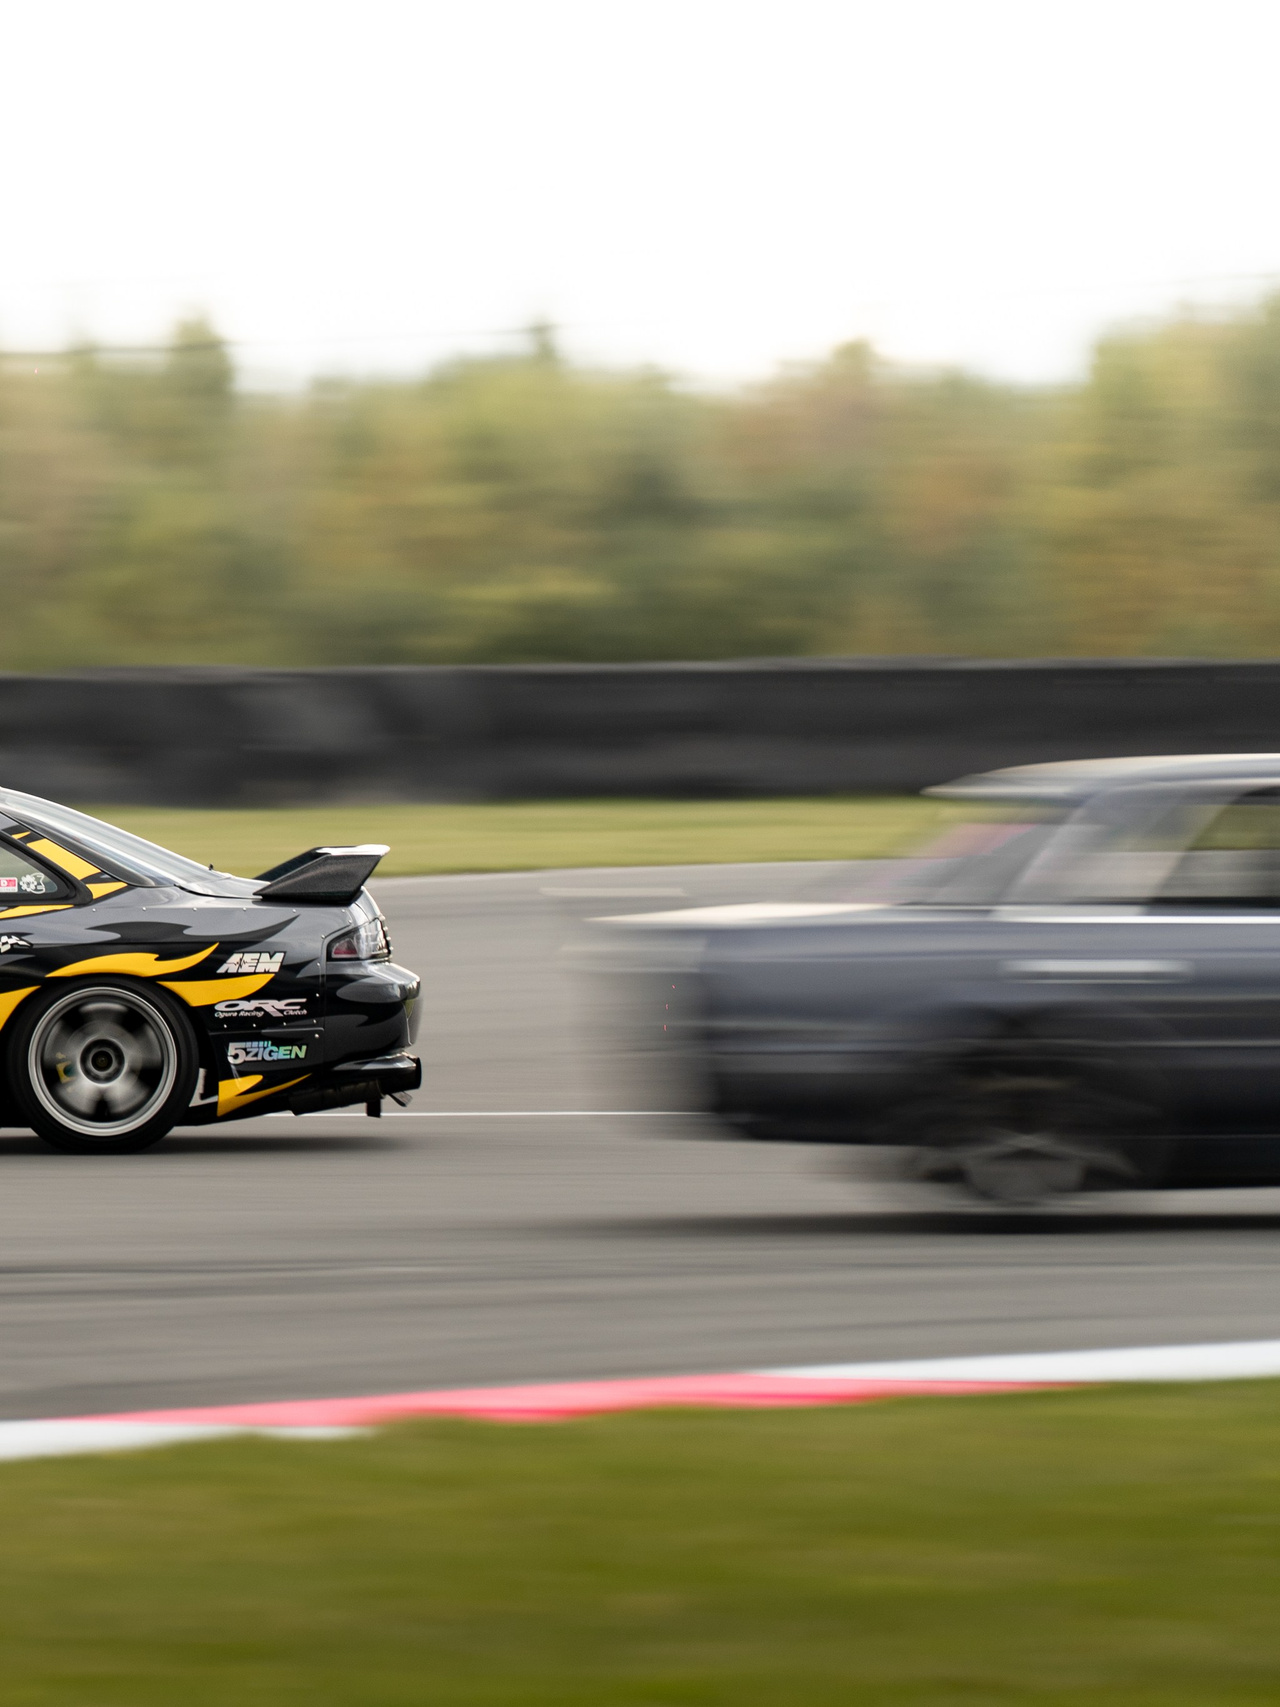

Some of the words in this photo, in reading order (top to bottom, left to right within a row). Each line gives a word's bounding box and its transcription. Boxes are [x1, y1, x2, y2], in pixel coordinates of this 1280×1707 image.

[216, 952, 284, 973] AEM
[214, 998, 307, 1017] ORC
[227, 1041, 307, 1065] 5ZIGEN
